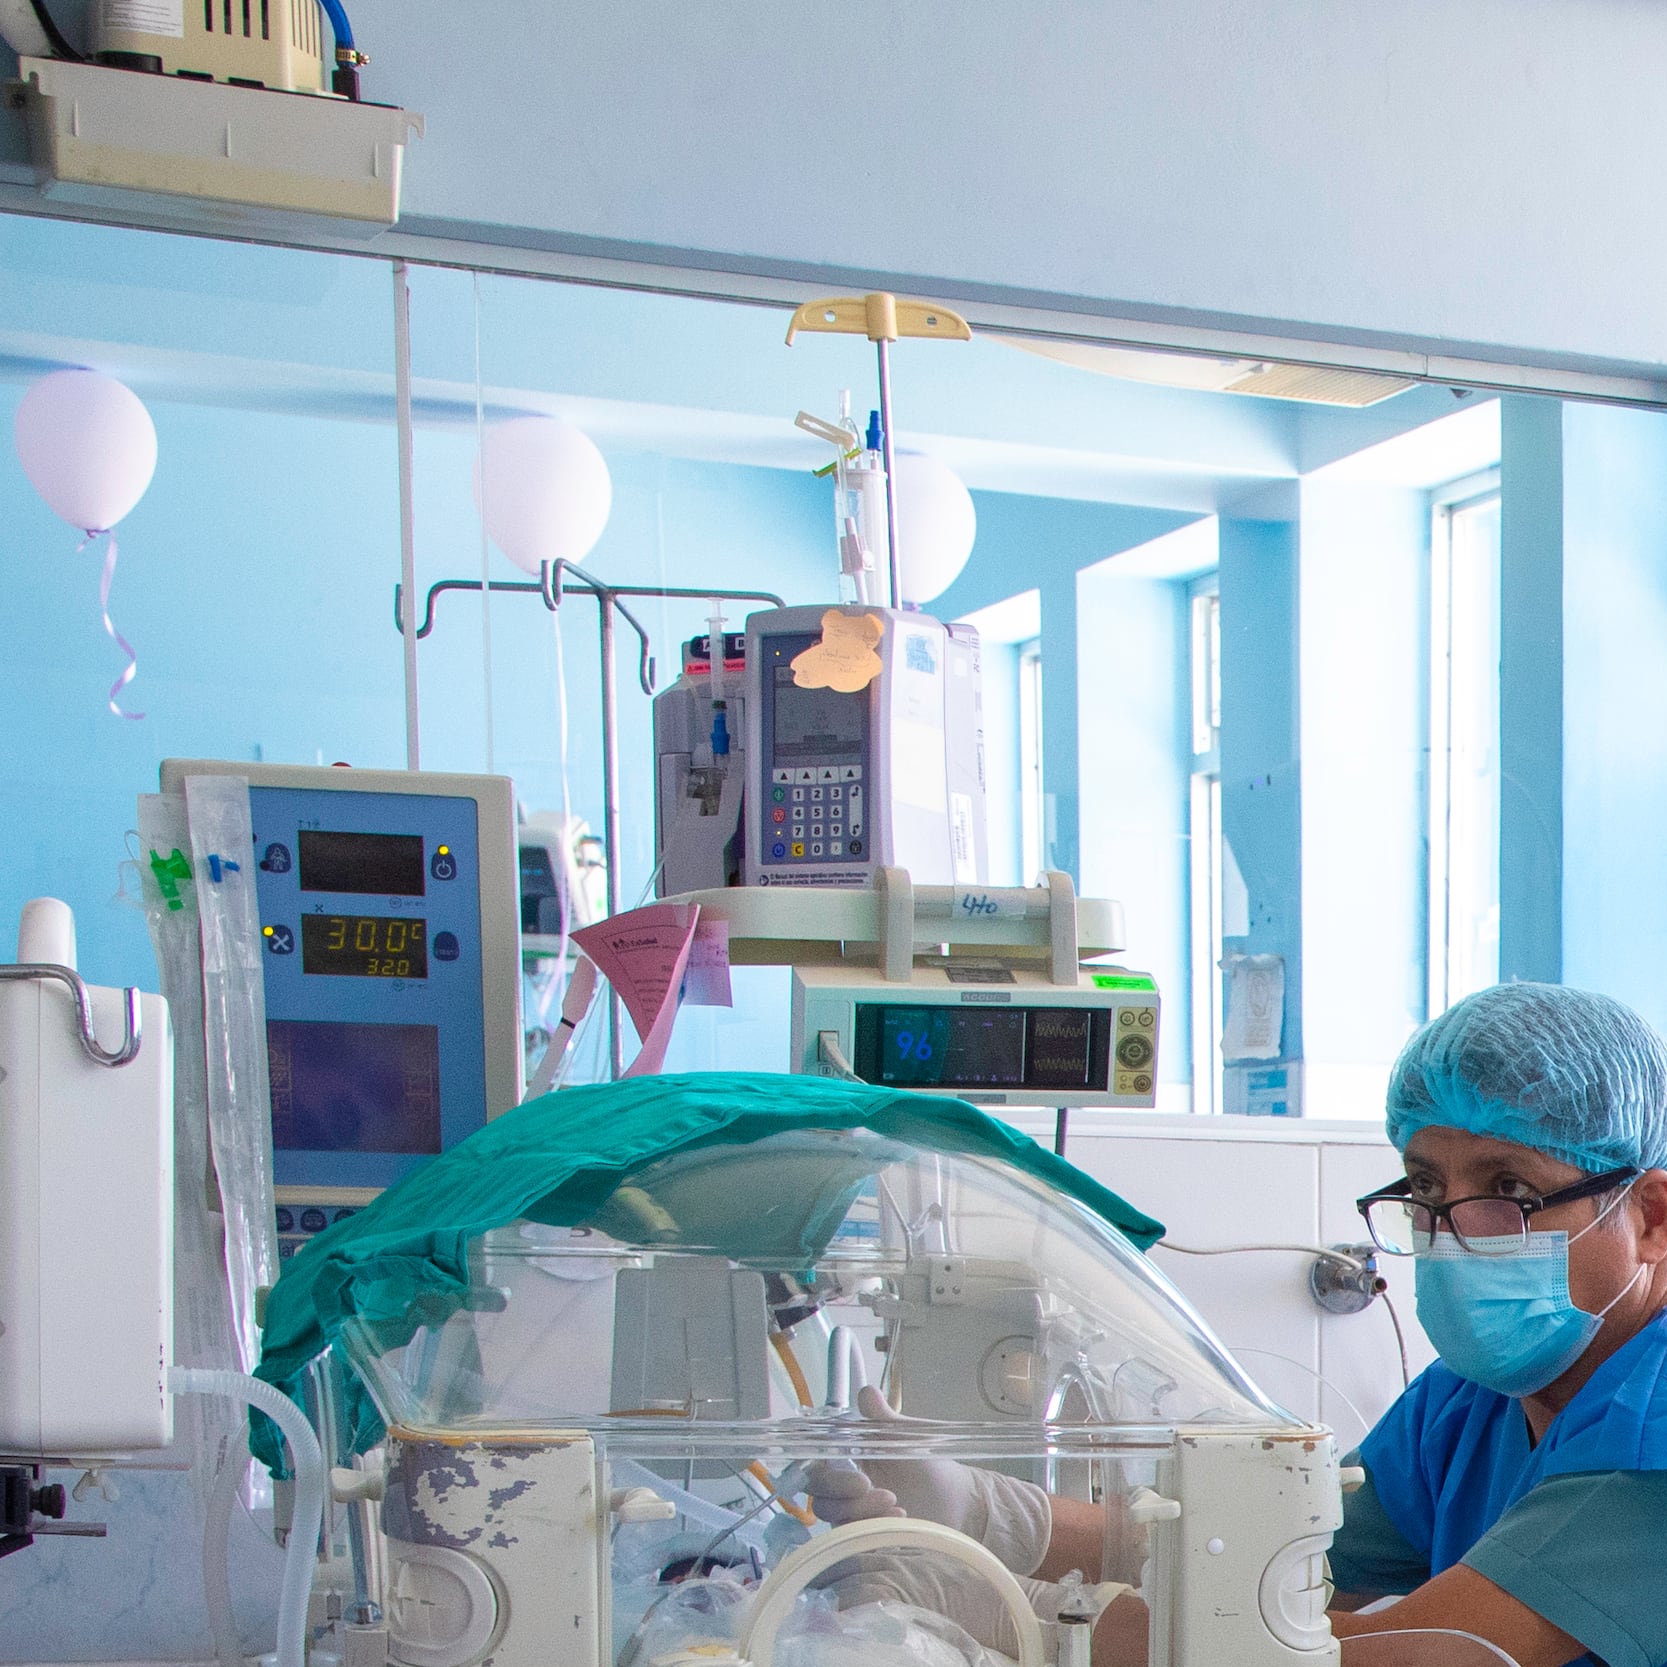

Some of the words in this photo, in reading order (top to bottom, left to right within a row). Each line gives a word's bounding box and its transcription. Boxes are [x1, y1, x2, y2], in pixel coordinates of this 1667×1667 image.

[796, 790, 801, 799] 1
[814, 790, 820, 798] 2
[833, 789, 839, 797] 3
[795, 808, 801, 817] 4
[814, 808, 820, 817] 5
[833, 807, 839, 816] 6
[795, 826, 801, 835] 7
[814, 826, 820, 834] 8
[833, 825, 839, 834] 9
[795, 845, 801, 854] C
[814, 845, 820, 853] 0
[328, 919, 407, 953] 30.0
[897, 1031, 932, 1060] 96
